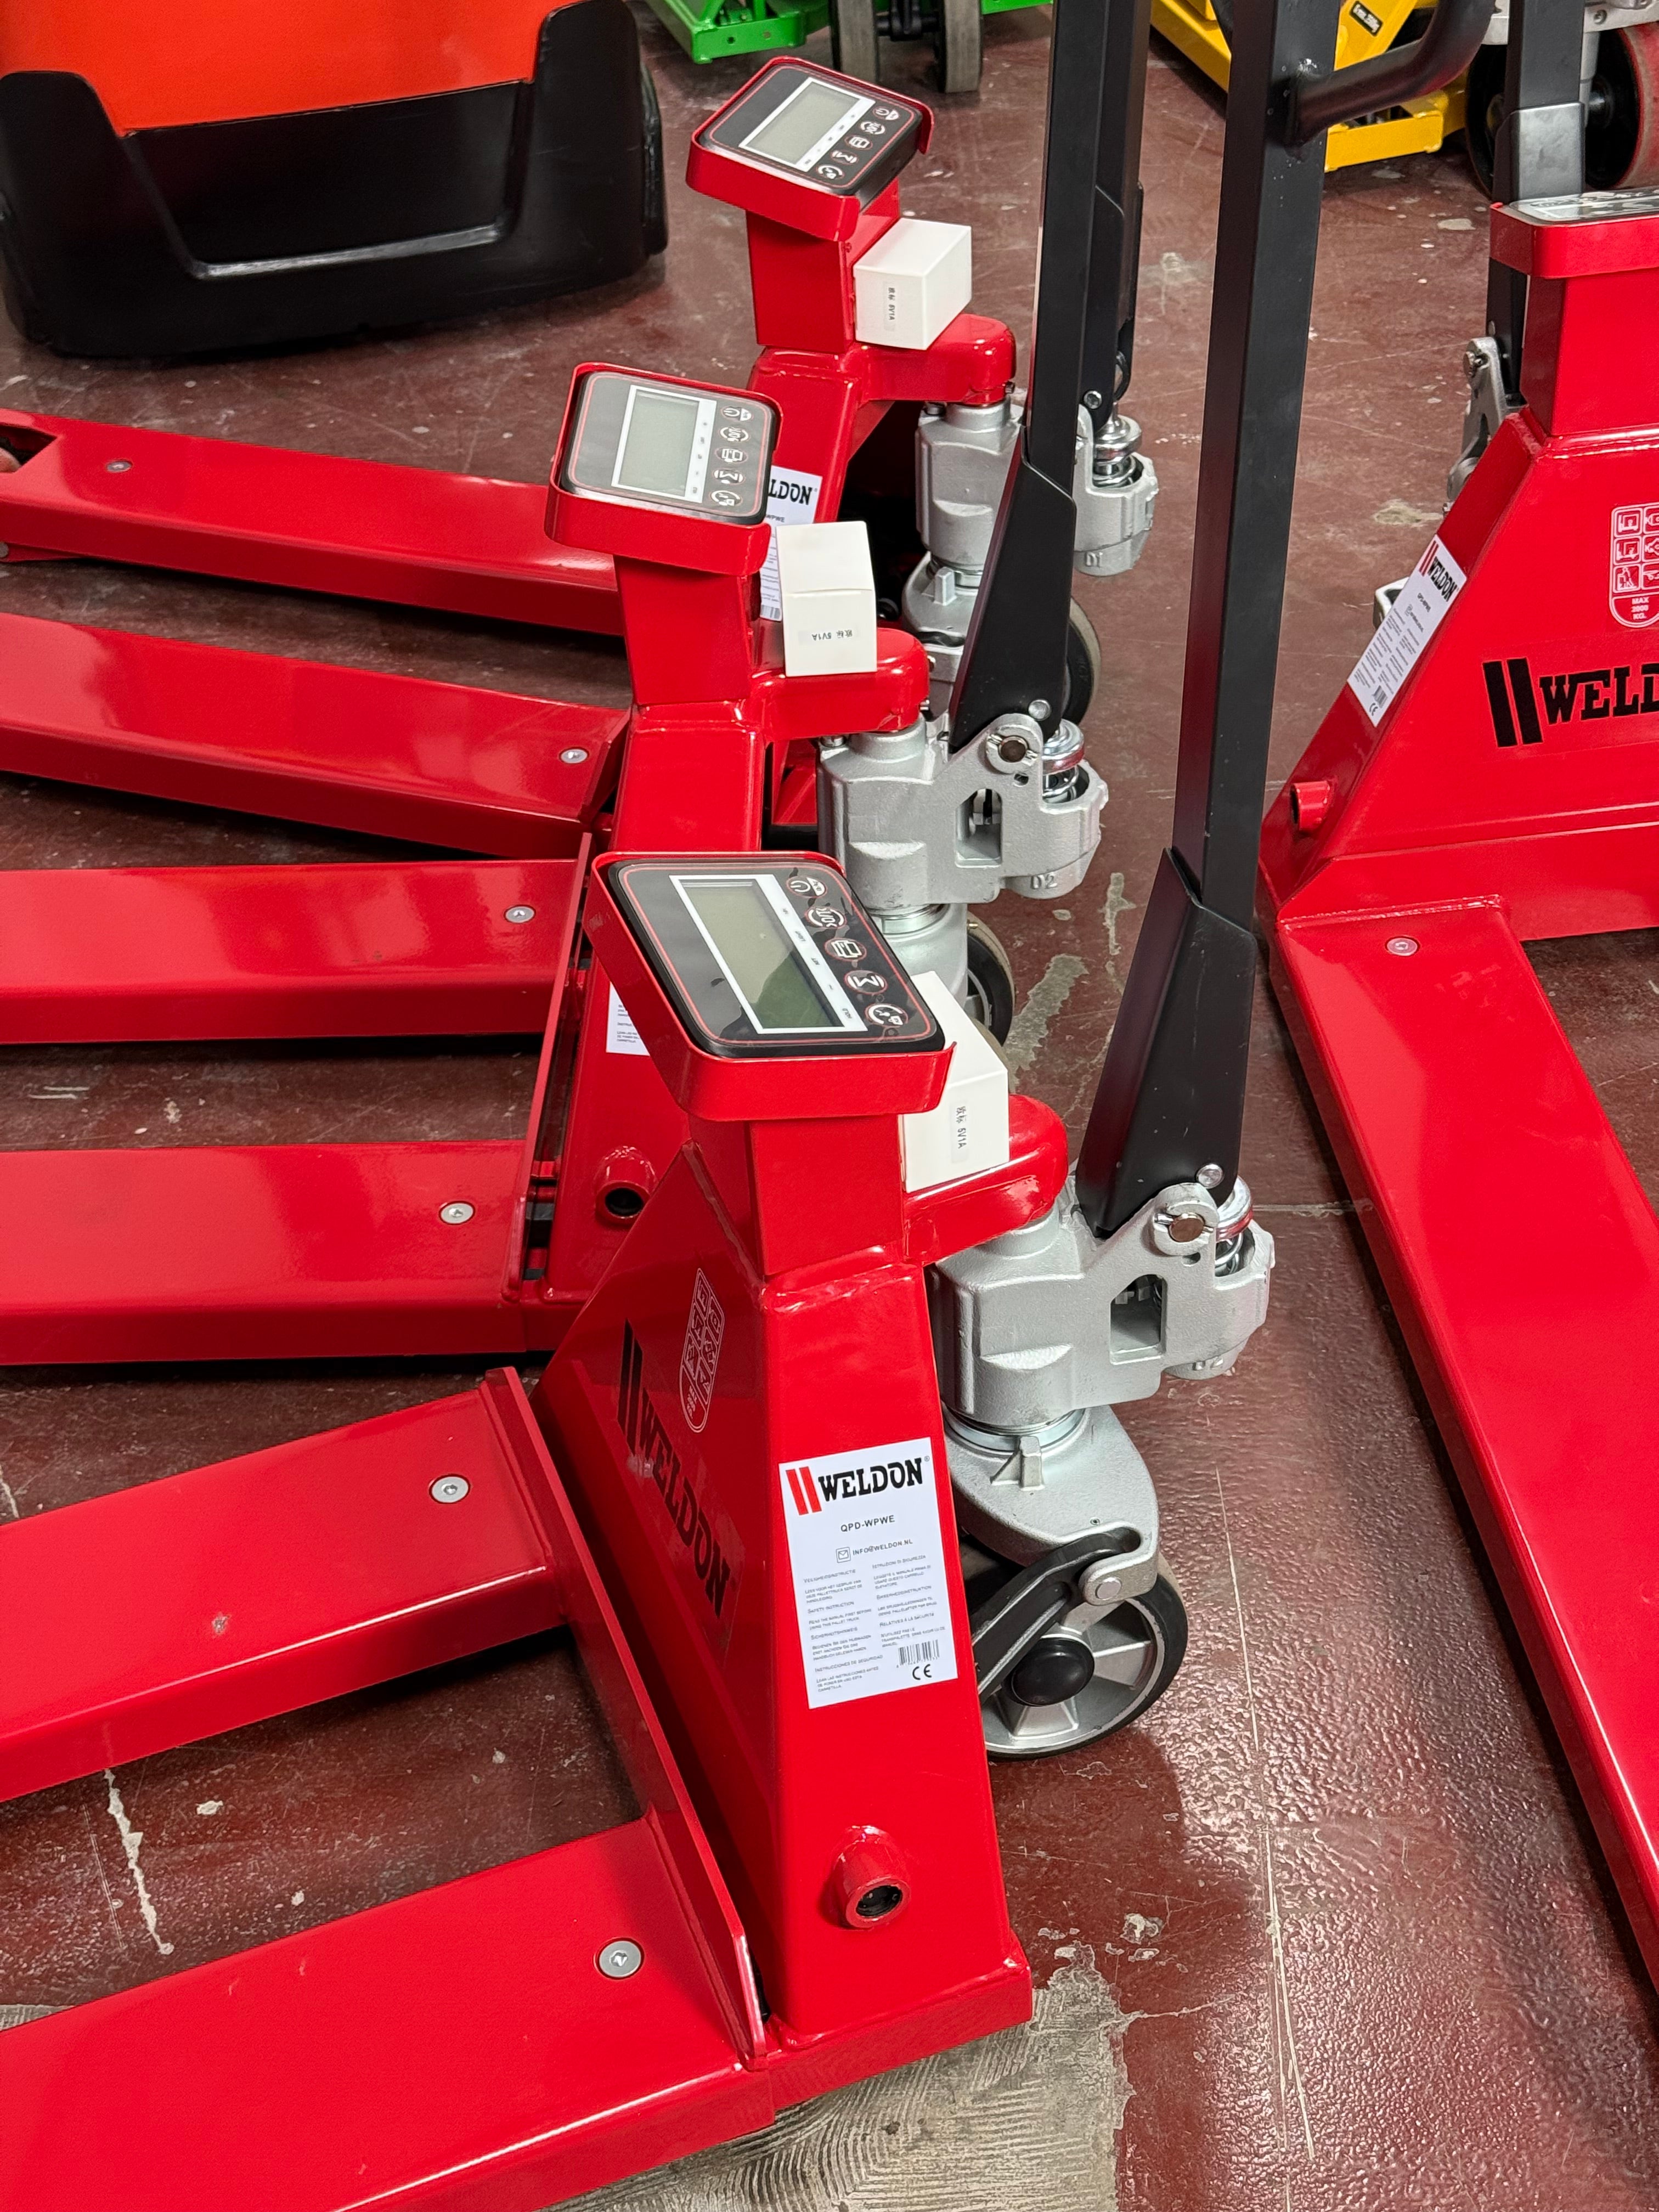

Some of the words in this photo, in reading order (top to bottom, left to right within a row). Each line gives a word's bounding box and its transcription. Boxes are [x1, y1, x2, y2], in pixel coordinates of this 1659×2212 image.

[768, 478, 812, 505] LDON
[1427, 556, 1458, 602] WELDON
[1632, 596, 1650, 605] MAX
[1539, 663, 1659, 725] WELD
[818, 1457, 923, 1502] WELDON
[639, 1387, 731, 1618] WELDON
[840, 1515, 895, 1532] QPD-WPWE
[853, 1539, 913, 1556] INFO@WELDON.NL
[912, 1663, 932, 1680] CE
